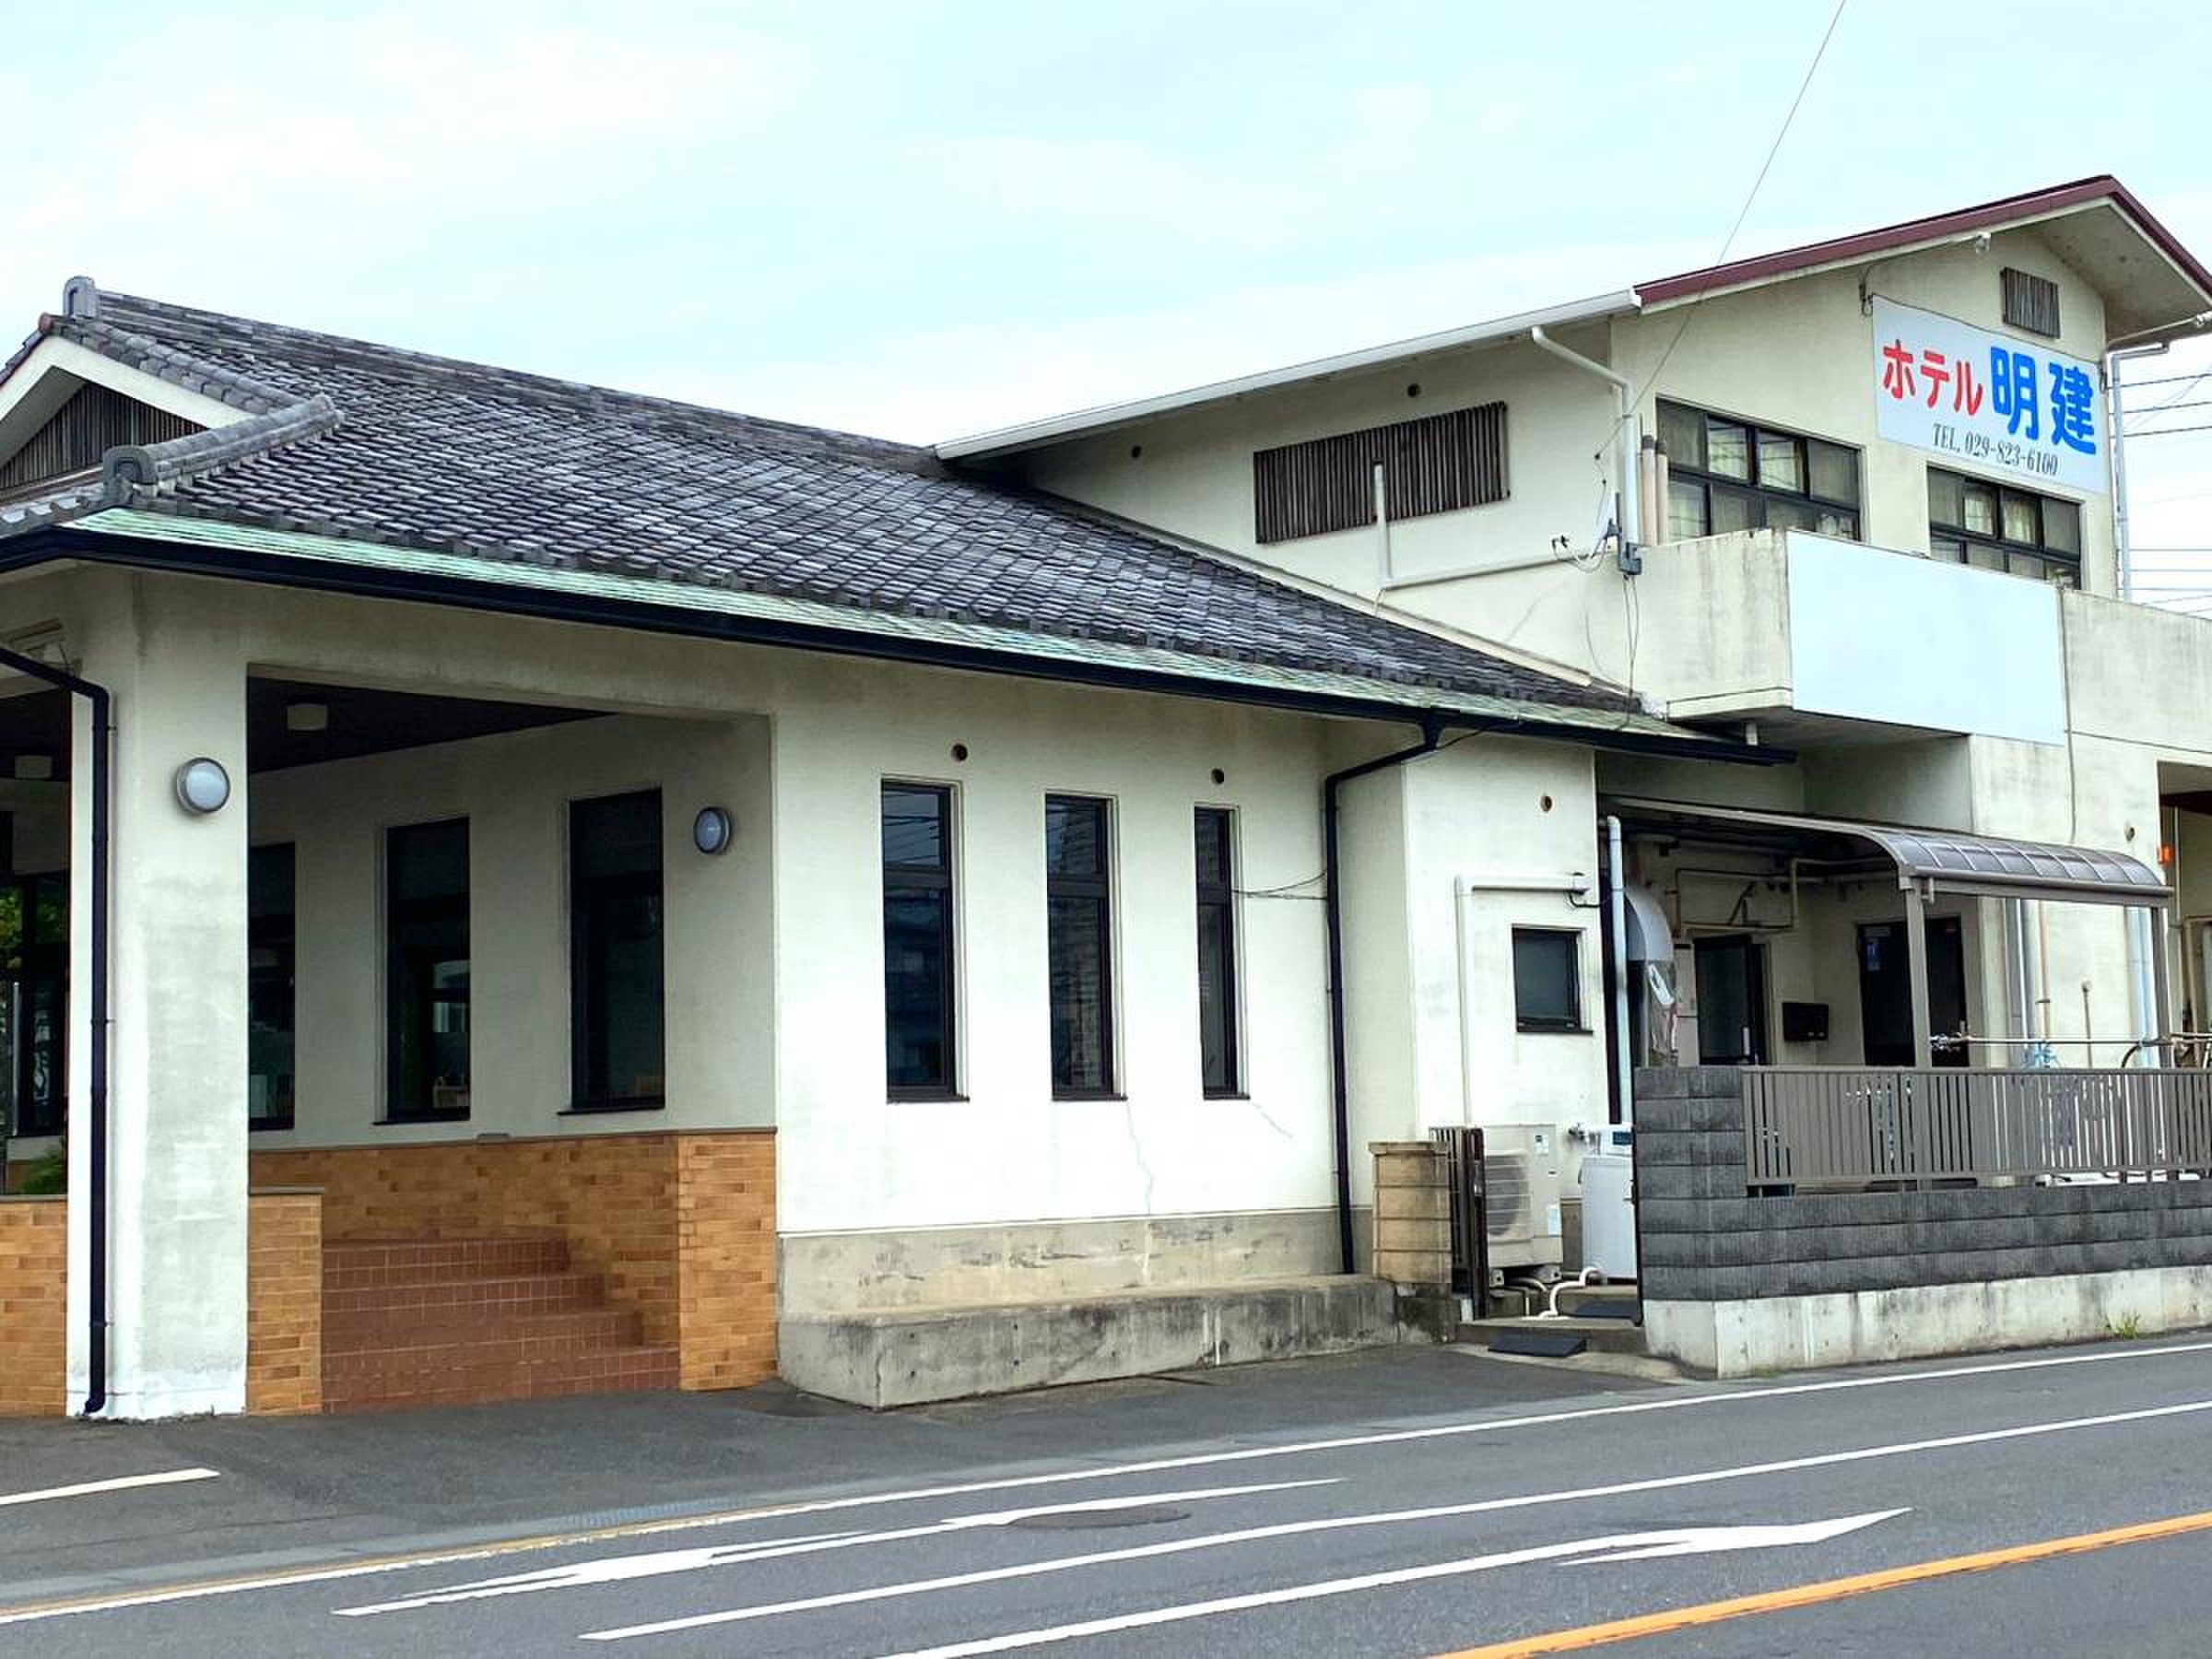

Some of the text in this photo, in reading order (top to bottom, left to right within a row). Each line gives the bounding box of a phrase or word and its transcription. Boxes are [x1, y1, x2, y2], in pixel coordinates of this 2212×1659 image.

[1883, 339, 2097, 455] ホテル明建
[1964, 430, 2059, 477] 029-823-6100
